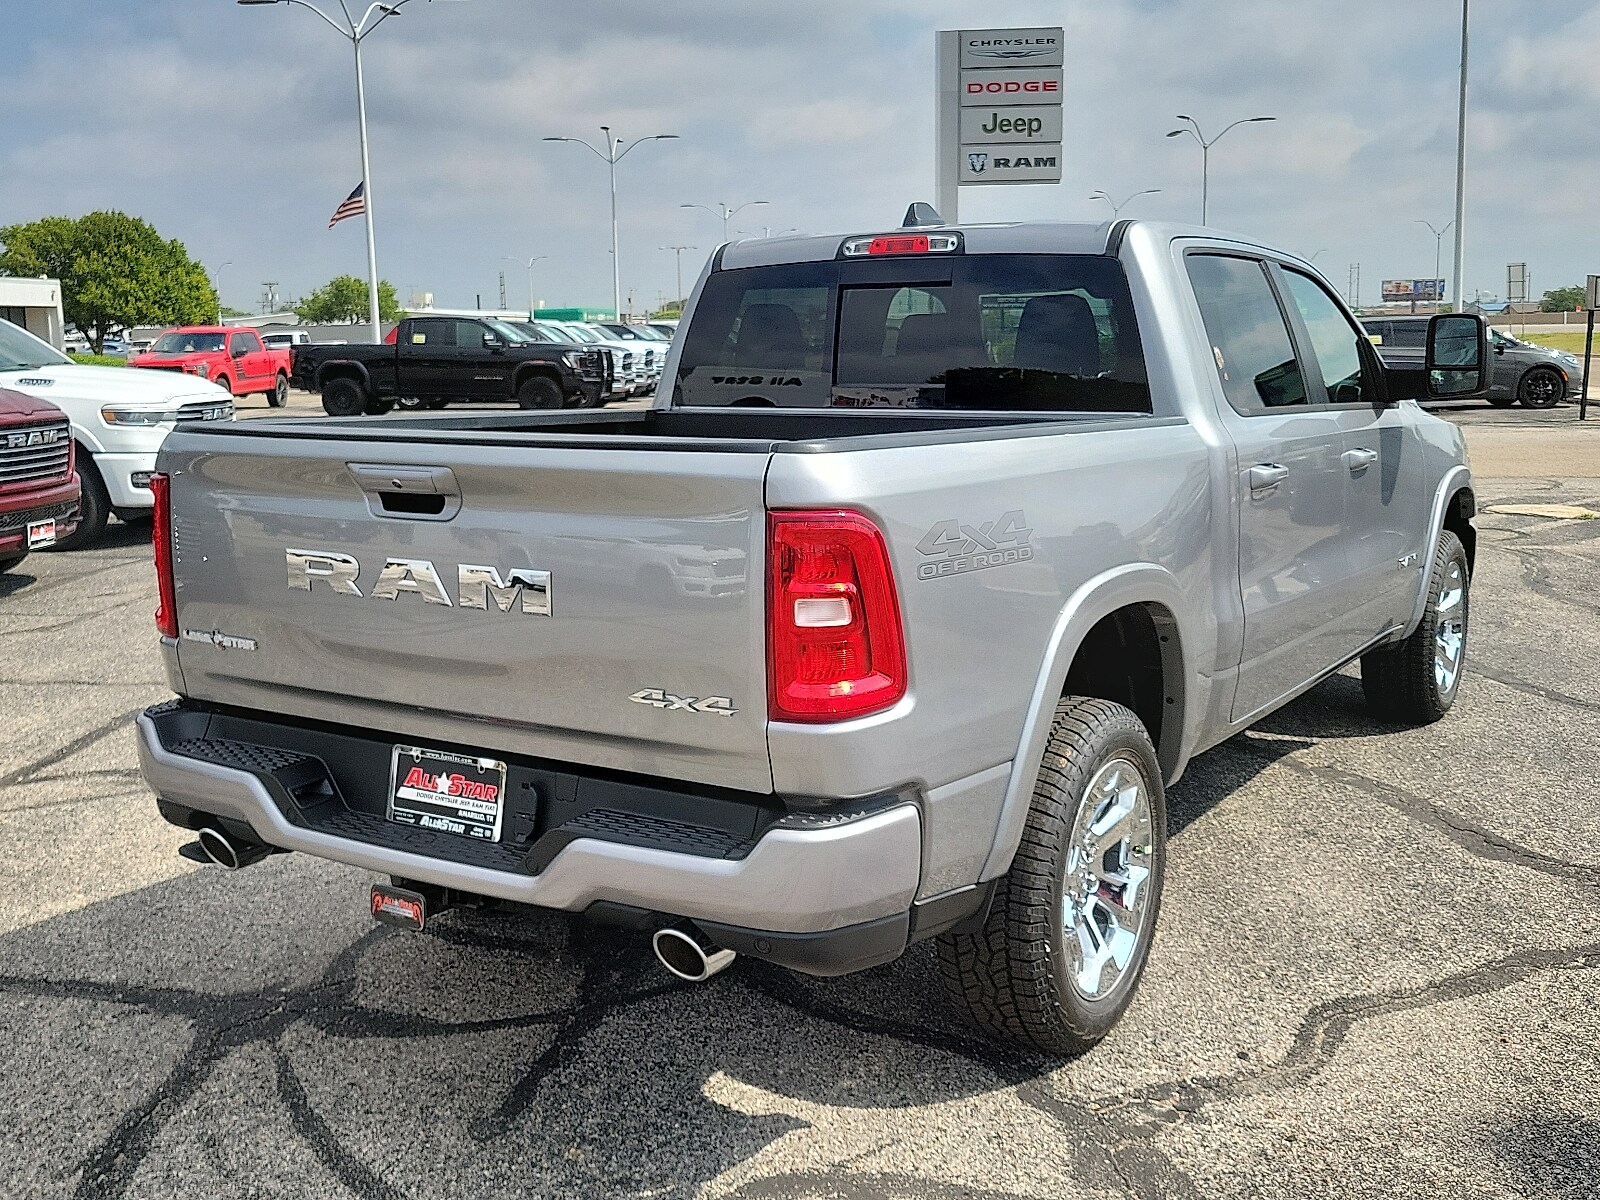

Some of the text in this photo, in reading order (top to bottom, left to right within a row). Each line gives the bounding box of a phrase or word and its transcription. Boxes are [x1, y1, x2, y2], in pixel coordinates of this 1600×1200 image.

[969, 38, 1056, 47] CHRYSLER
[966, 81, 1058, 94] DODGE
[981, 112, 1042, 138] Jeep
[993, 156, 1057, 169] RAM
[919, 546, 1033, 579] OFF ROAD
[286, 548, 553, 617] RAM
